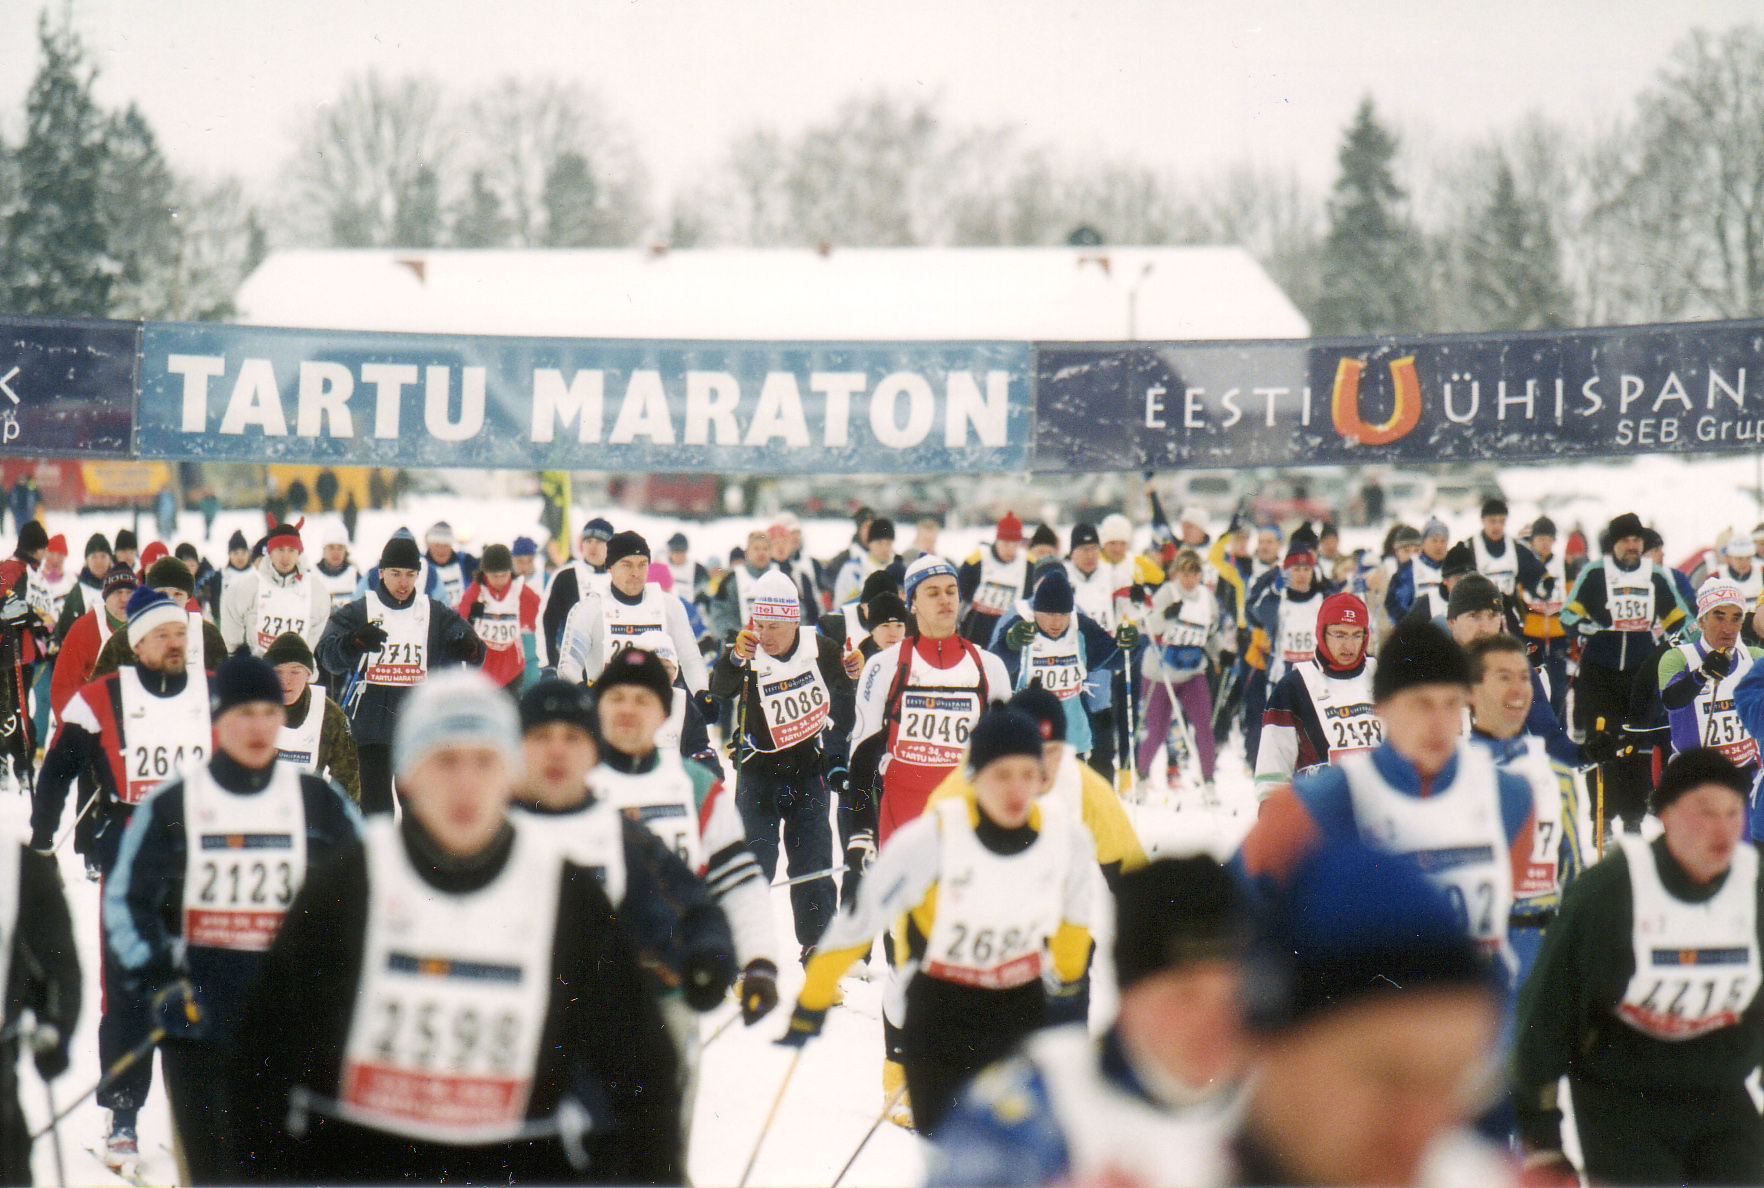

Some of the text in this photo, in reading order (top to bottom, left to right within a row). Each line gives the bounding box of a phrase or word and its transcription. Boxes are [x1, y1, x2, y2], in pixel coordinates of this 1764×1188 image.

[167, 353, 1011, 449] TARTU MARATON
[1145, 386, 1311, 428] EESTI
[1615, 418, 1679, 446] SEB
[377, 642, 422, 665] 2715
[771, 686, 823, 725] 2086
[906, 713, 970, 744] 2046
[201, 862, 294, 904] 2123
